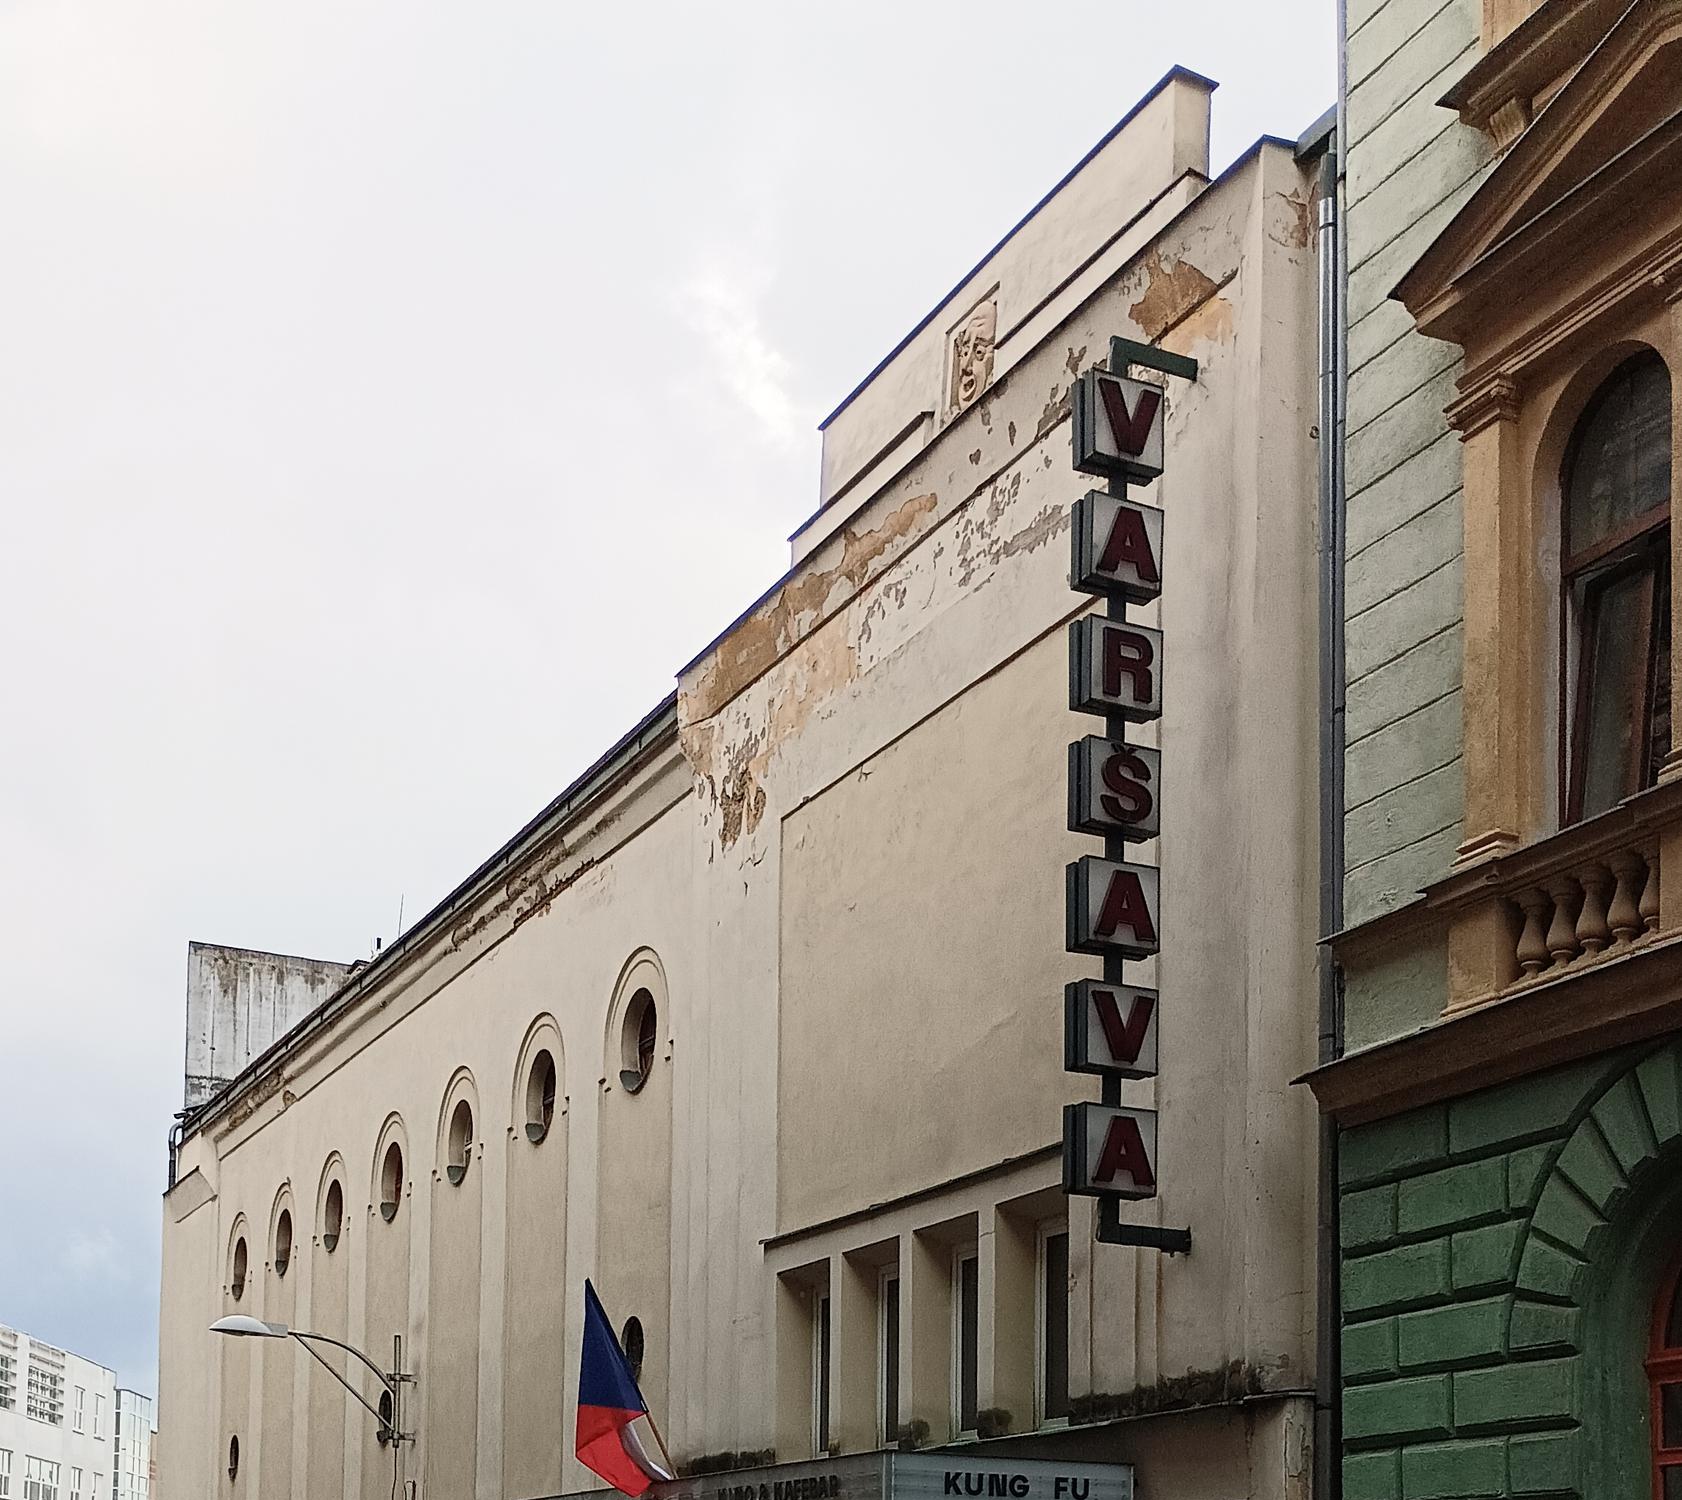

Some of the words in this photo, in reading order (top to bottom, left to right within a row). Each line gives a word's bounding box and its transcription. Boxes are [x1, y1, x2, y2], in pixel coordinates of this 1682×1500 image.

[1091, 378, 1161, 1186] VARŠAVA
[944, 1471, 1030, 1498] KUNG
[1054, 1476, 1090, 1500] FU
